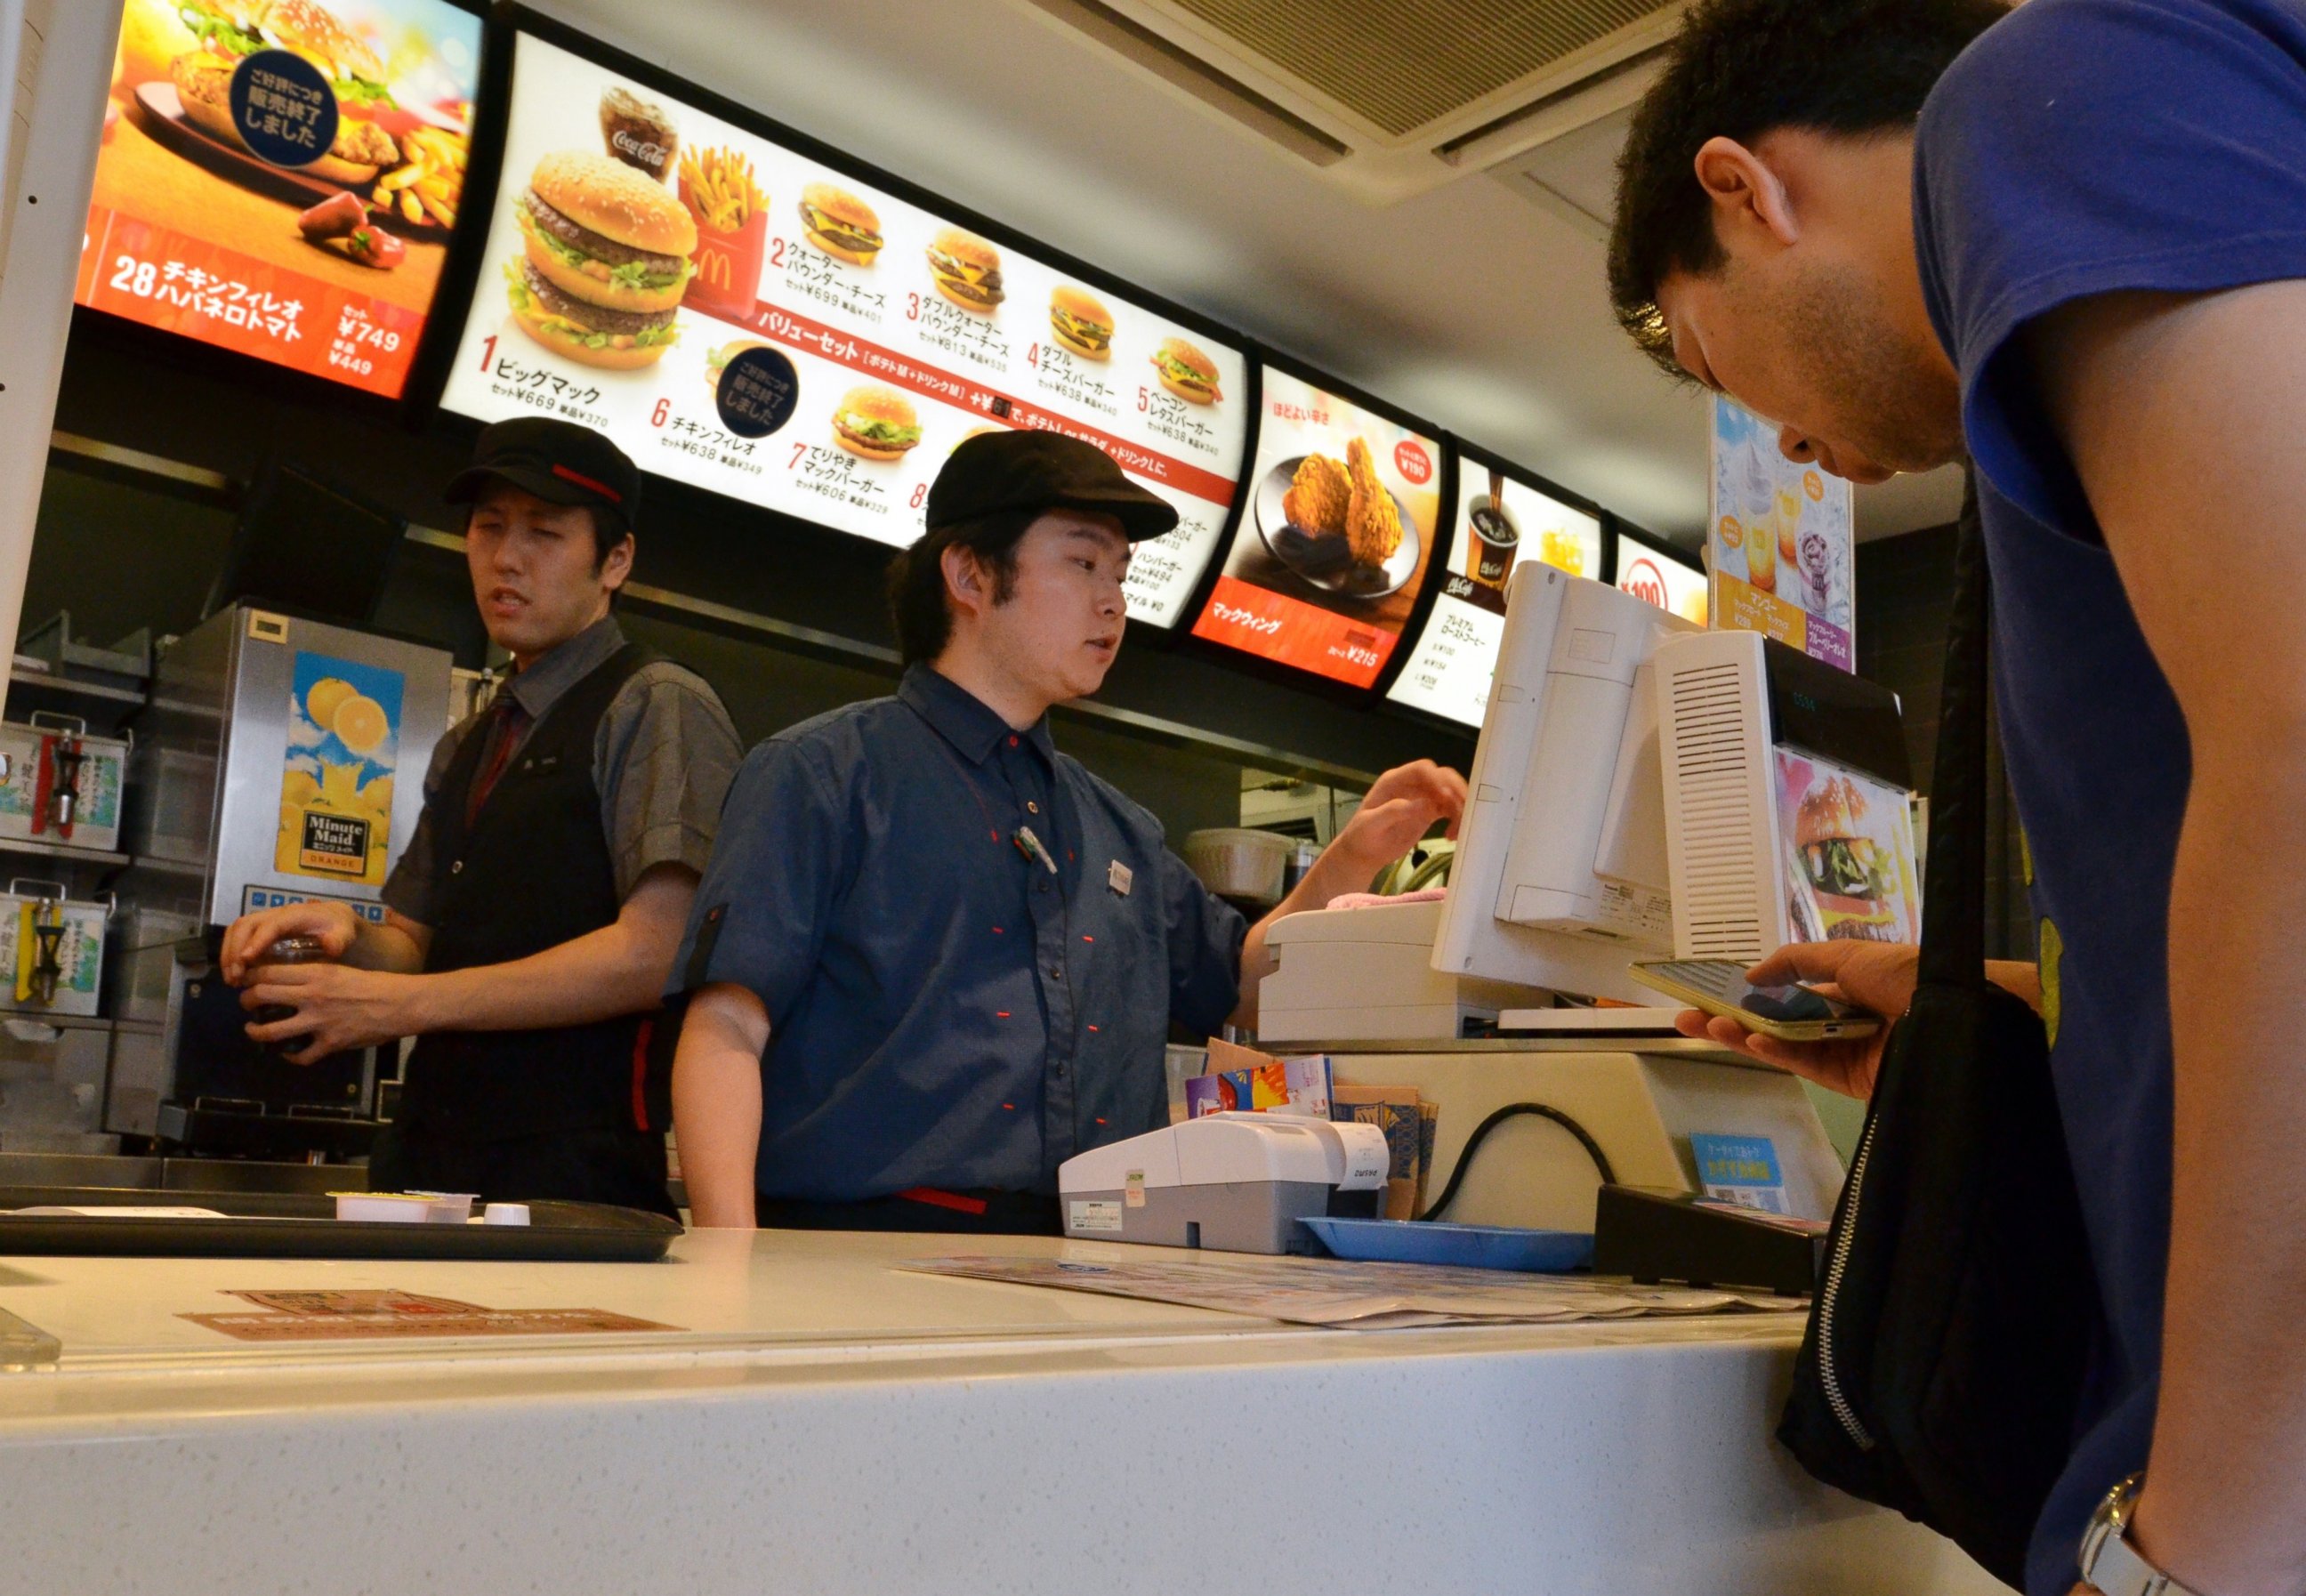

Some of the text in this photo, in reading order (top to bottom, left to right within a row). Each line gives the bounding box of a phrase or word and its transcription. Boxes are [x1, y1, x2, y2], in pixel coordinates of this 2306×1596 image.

[248, 85, 321, 126] 販売終了
[246, 106, 316, 149] しました
[770, 237, 784, 268] 2
[109, 254, 157, 297] 28
[162, 260, 303, 320] チキンフィレオ
[155, 284, 302, 342] ハバネロトマト
[907, 292, 919, 320] 3
[338, 315, 399, 352] ¥749
[758, 311, 859, 361] バリューセット
[328, 350, 373, 375] ¥449
[480, 335, 498, 372] 1
[1028, 342, 1038, 368] 4
[1042, 345, 1072, 367] ダブル
[496, 358, 601, 404] ビッグマック
[491, 383, 556, 410] セット¥669
[725, 390, 775, 426] しました
[1138, 386, 1148, 412] 5
[651, 398, 671, 427] 6
[1150, 403, 1213, 436] レタスバーガー
[1273, 402, 1329, 426] ほどよい辛さ
[673, 416, 756, 455] チキンフィレオ
[788, 442, 807, 470] 7
[810, 446, 857, 472] てりやき
[804, 460, 884, 494] マックバーガー
[910, 483, 927, 509] 8
[1137, 552, 1182, 571] ハンバーガー
[1213, 601, 1282, 635] マックウィング
[1441, 625, 1486, 647] ローストコーヒー
[1347, 645, 1379, 667] ¥215
[310, 816, 363, 835] Minute
[314, 829, 353, 846] Maid
[310, 855, 354, 867] ORANGE
